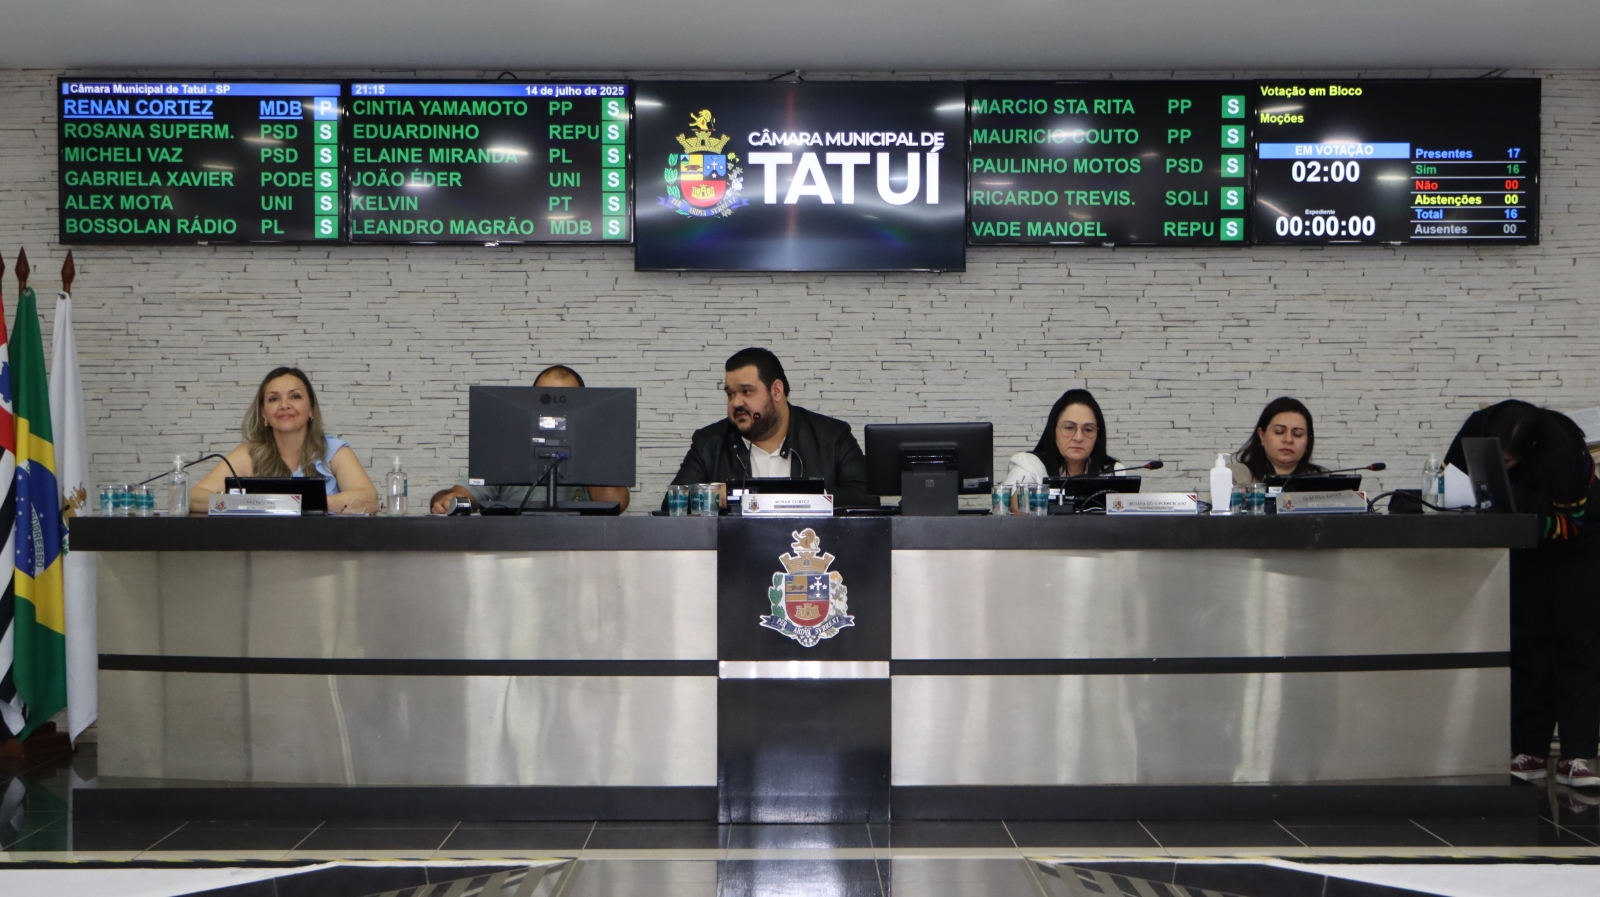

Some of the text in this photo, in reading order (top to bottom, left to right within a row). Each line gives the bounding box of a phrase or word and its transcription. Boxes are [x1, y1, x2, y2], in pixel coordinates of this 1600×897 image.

[70, 84, 111, 94] Câmara
[113, 84, 163, 96] Municipal
[165, 85, 179, 94] de
[216, 85, 230, 94] SP
[356, 85, 385, 95] 21:15
[526, 86, 624, 97] 14 de julho de 2025
[1261, 85, 1362, 98] Votação em Bloco
[64, 100, 332, 115] RENAN CORTEZ MDB P
[353, 100, 620, 116] CINTIA YAMAMOTO PP S
[973, 99, 1239, 114] MARCIO STA RITA PP S
[1260, 114, 1304, 125] Moções
[65, 124, 332, 139] ROSANA SUPERM. PSD S
[353, 124, 620, 140] EDUARDINHO REPU S
[748, 129, 944, 147] CÂMARA MUNICIPAL DE
[972, 129, 1239, 144] MAURICIO COUTO PP S
[65, 148, 332, 163] MICHELI VAZ PSD S
[353, 148, 620, 163] ELAINE MIRANDA PL S
[1295, 143, 1374, 158] EM VOTAÇÃO
[1415, 148, 1520, 159] Presentes 17
[973, 158, 1239, 173] PAULINHO MOTOS PSD S
[1291, 160, 1360, 182] 02:00
[1415, 164, 1519, 175] Sim 16
[65, 171, 332, 187] GABRIELA XAVIER PODE S
[353, 168, 620, 187] JOÃO ÉDER UNI S
[748, 145, 944, 205] TATUÍ
[1415, 180, 1519, 190] Não 00
[65, 195, 332, 210] ALEX MOTA UNI S
[352, 196, 620, 211] KELVIN PT S
[671, 197, 682, 207] PER
[972, 190, 1239, 206] RICARDO TREVIS. SOLI S
[1415, 194, 1518, 207] Abstenções 00
[1415, 209, 1518, 219] Total 16
[66, 215, 332, 234] BOSSOLAN RÁDIO PL S
[352, 215, 620, 235] LEANDRO MAGRÃO MDB S
[972, 222, 1238, 237] VADE MANOEL REPU S
[1275, 215, 1376, 236] 00:00:00
[1415, 224, 1517, 234] Ausentes 00
[776, 618, 787, 628] PER
